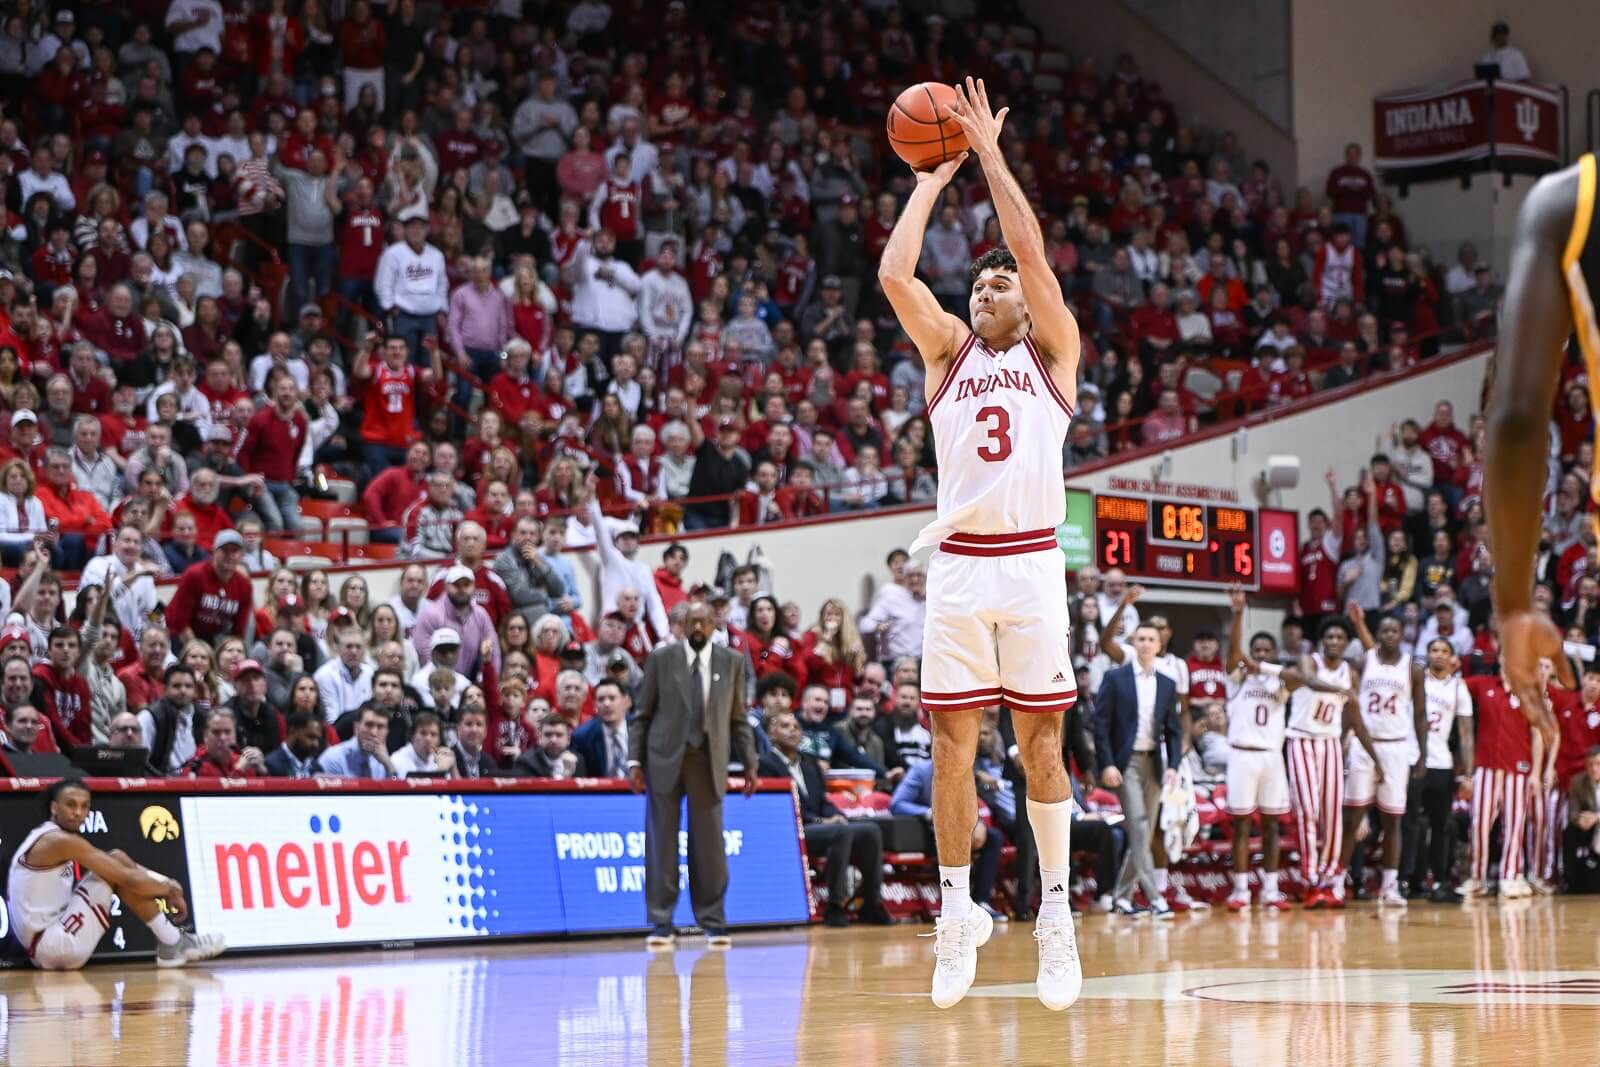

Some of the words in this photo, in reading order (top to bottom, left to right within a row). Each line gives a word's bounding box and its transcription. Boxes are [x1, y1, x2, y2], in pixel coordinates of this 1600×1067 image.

[1385, 97, 1474, 137] INDIANA
[955, 369, 1037, 402] INDIANA
[976, 406, 1012, 462] 3
[1105, 530, 1131, 565] 27
[1233, 541, 1252, 576] 15
[1255, 703, 1268, 727] 0
[1313, 700, 1336, 725] 10
[1368, 691, 1399, 715] 24
[555, 832, 625, 860] PROUD
[215, 814, 410, 929] meijer
[595, 866, 618, 893] IU
[113, 927, 126, 949] 4
